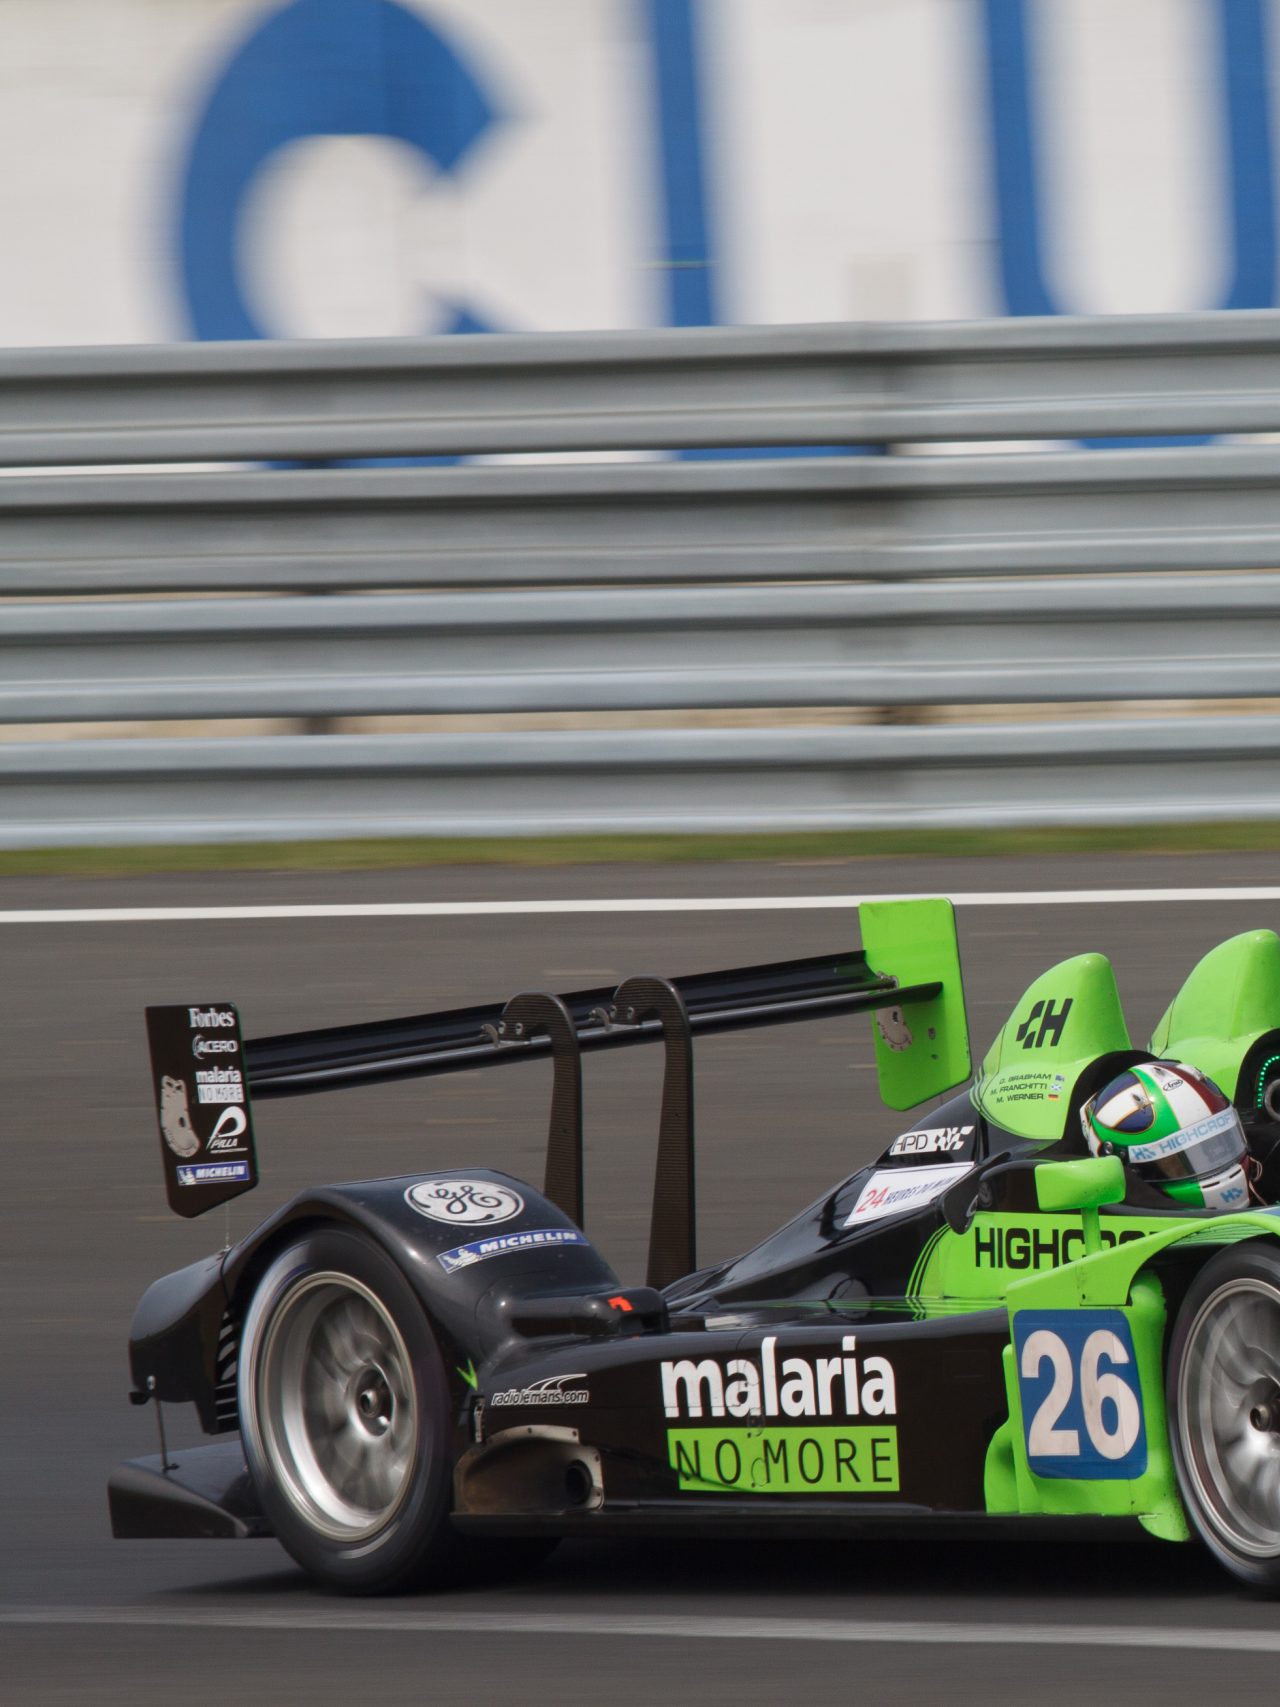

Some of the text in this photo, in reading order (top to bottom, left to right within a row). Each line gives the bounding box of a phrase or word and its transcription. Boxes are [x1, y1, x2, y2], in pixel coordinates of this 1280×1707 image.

[188, 1007, 235, 1028] Forbes
[196, 1066, 242, 1083] malaria
[1008, 1073, 1052, 1083] BRABHAM
[200, 1085, 243, 1101] NO MORE
[1000, 1082, 1047, 1093] FRANCHITTI
[1007, 1093, 1044, 1102] WERNER
[892, 1134, 929, 1153] HPD
[196, 1165, 245, 1179] MICHELIN
[855, 1187, 889, 1213] 24
[479, 1231, 578, 1254] MICHELIN
[975, 1227, 1158, 1269] HIGHC
[660, 1335, 897, 1418] malaria
[491, 1388, 589, 1406] radiolemans.com
[1021, 1329, 1140, 1460] 26
[675, 1438, 893, 1484] NO MORE
